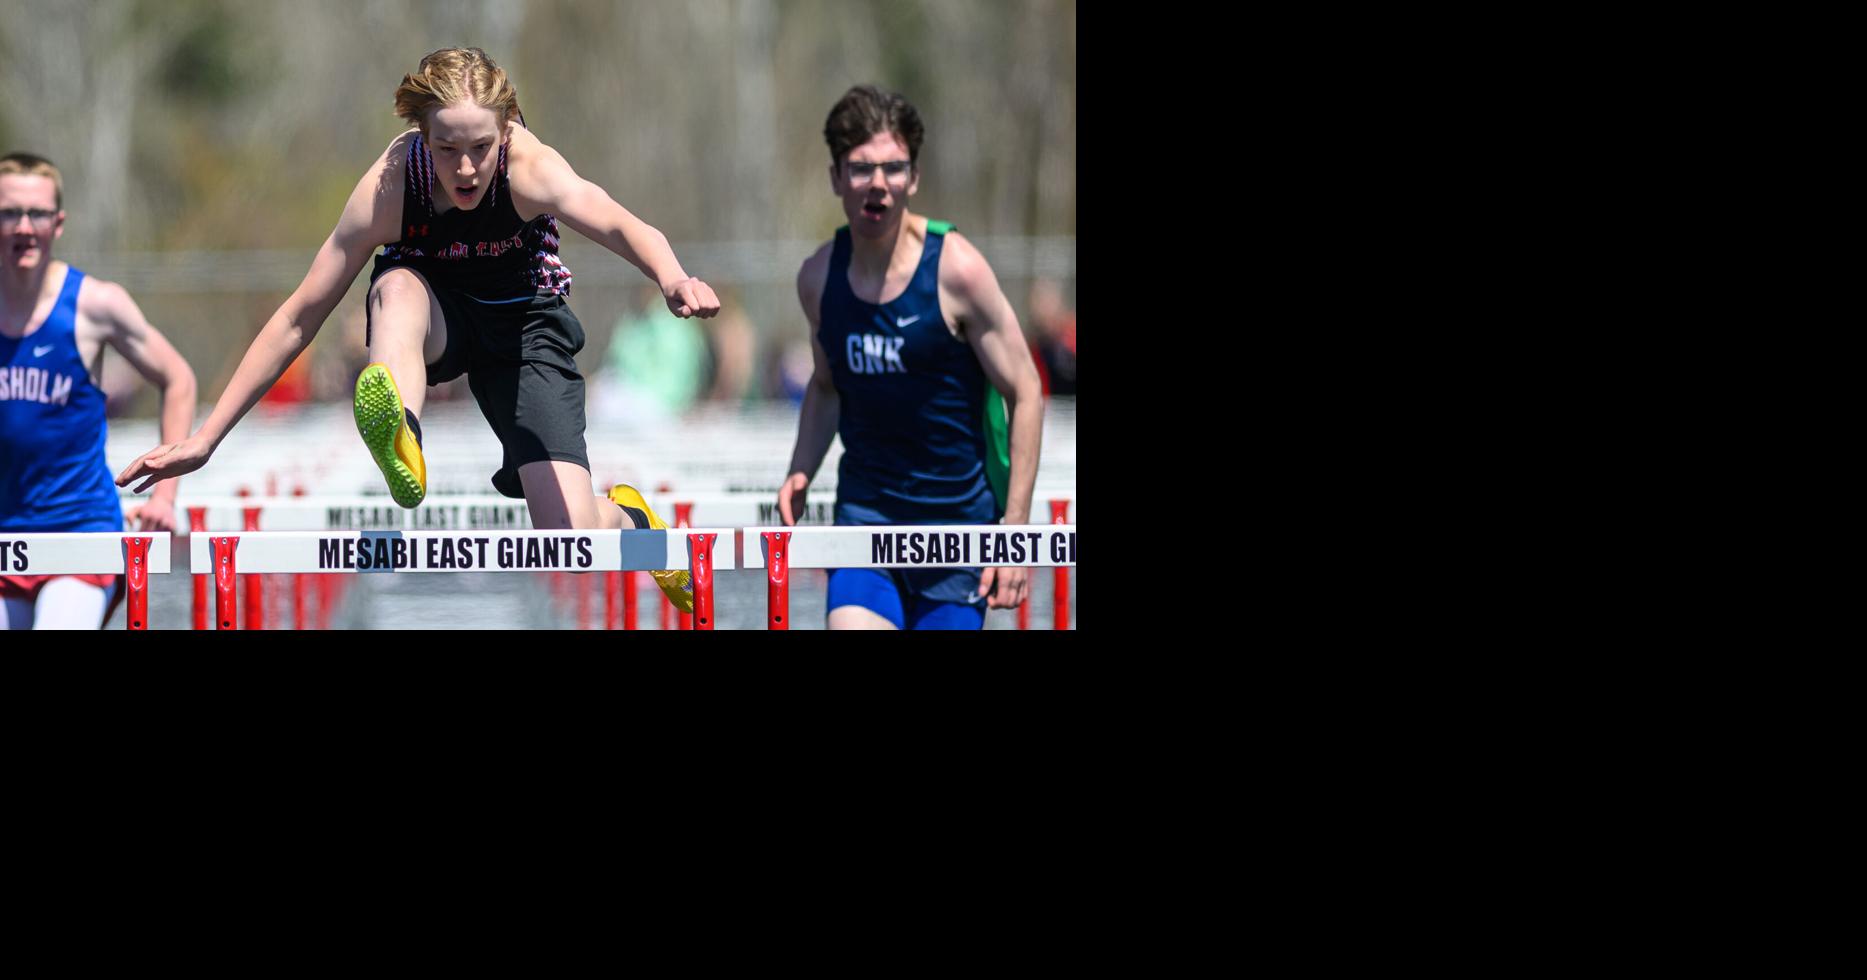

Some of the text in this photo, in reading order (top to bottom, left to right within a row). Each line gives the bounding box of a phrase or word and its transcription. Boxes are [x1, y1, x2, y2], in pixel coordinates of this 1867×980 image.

[846, 333, 908, 375] GNK
[0, 366, 73, 407] SHOLM
[0, 540, 29, 572] TS
[319, 536, 593, 570] MESABI EAST GIANTS
[871, 532, 1076, 564] MESABI EAST GI
